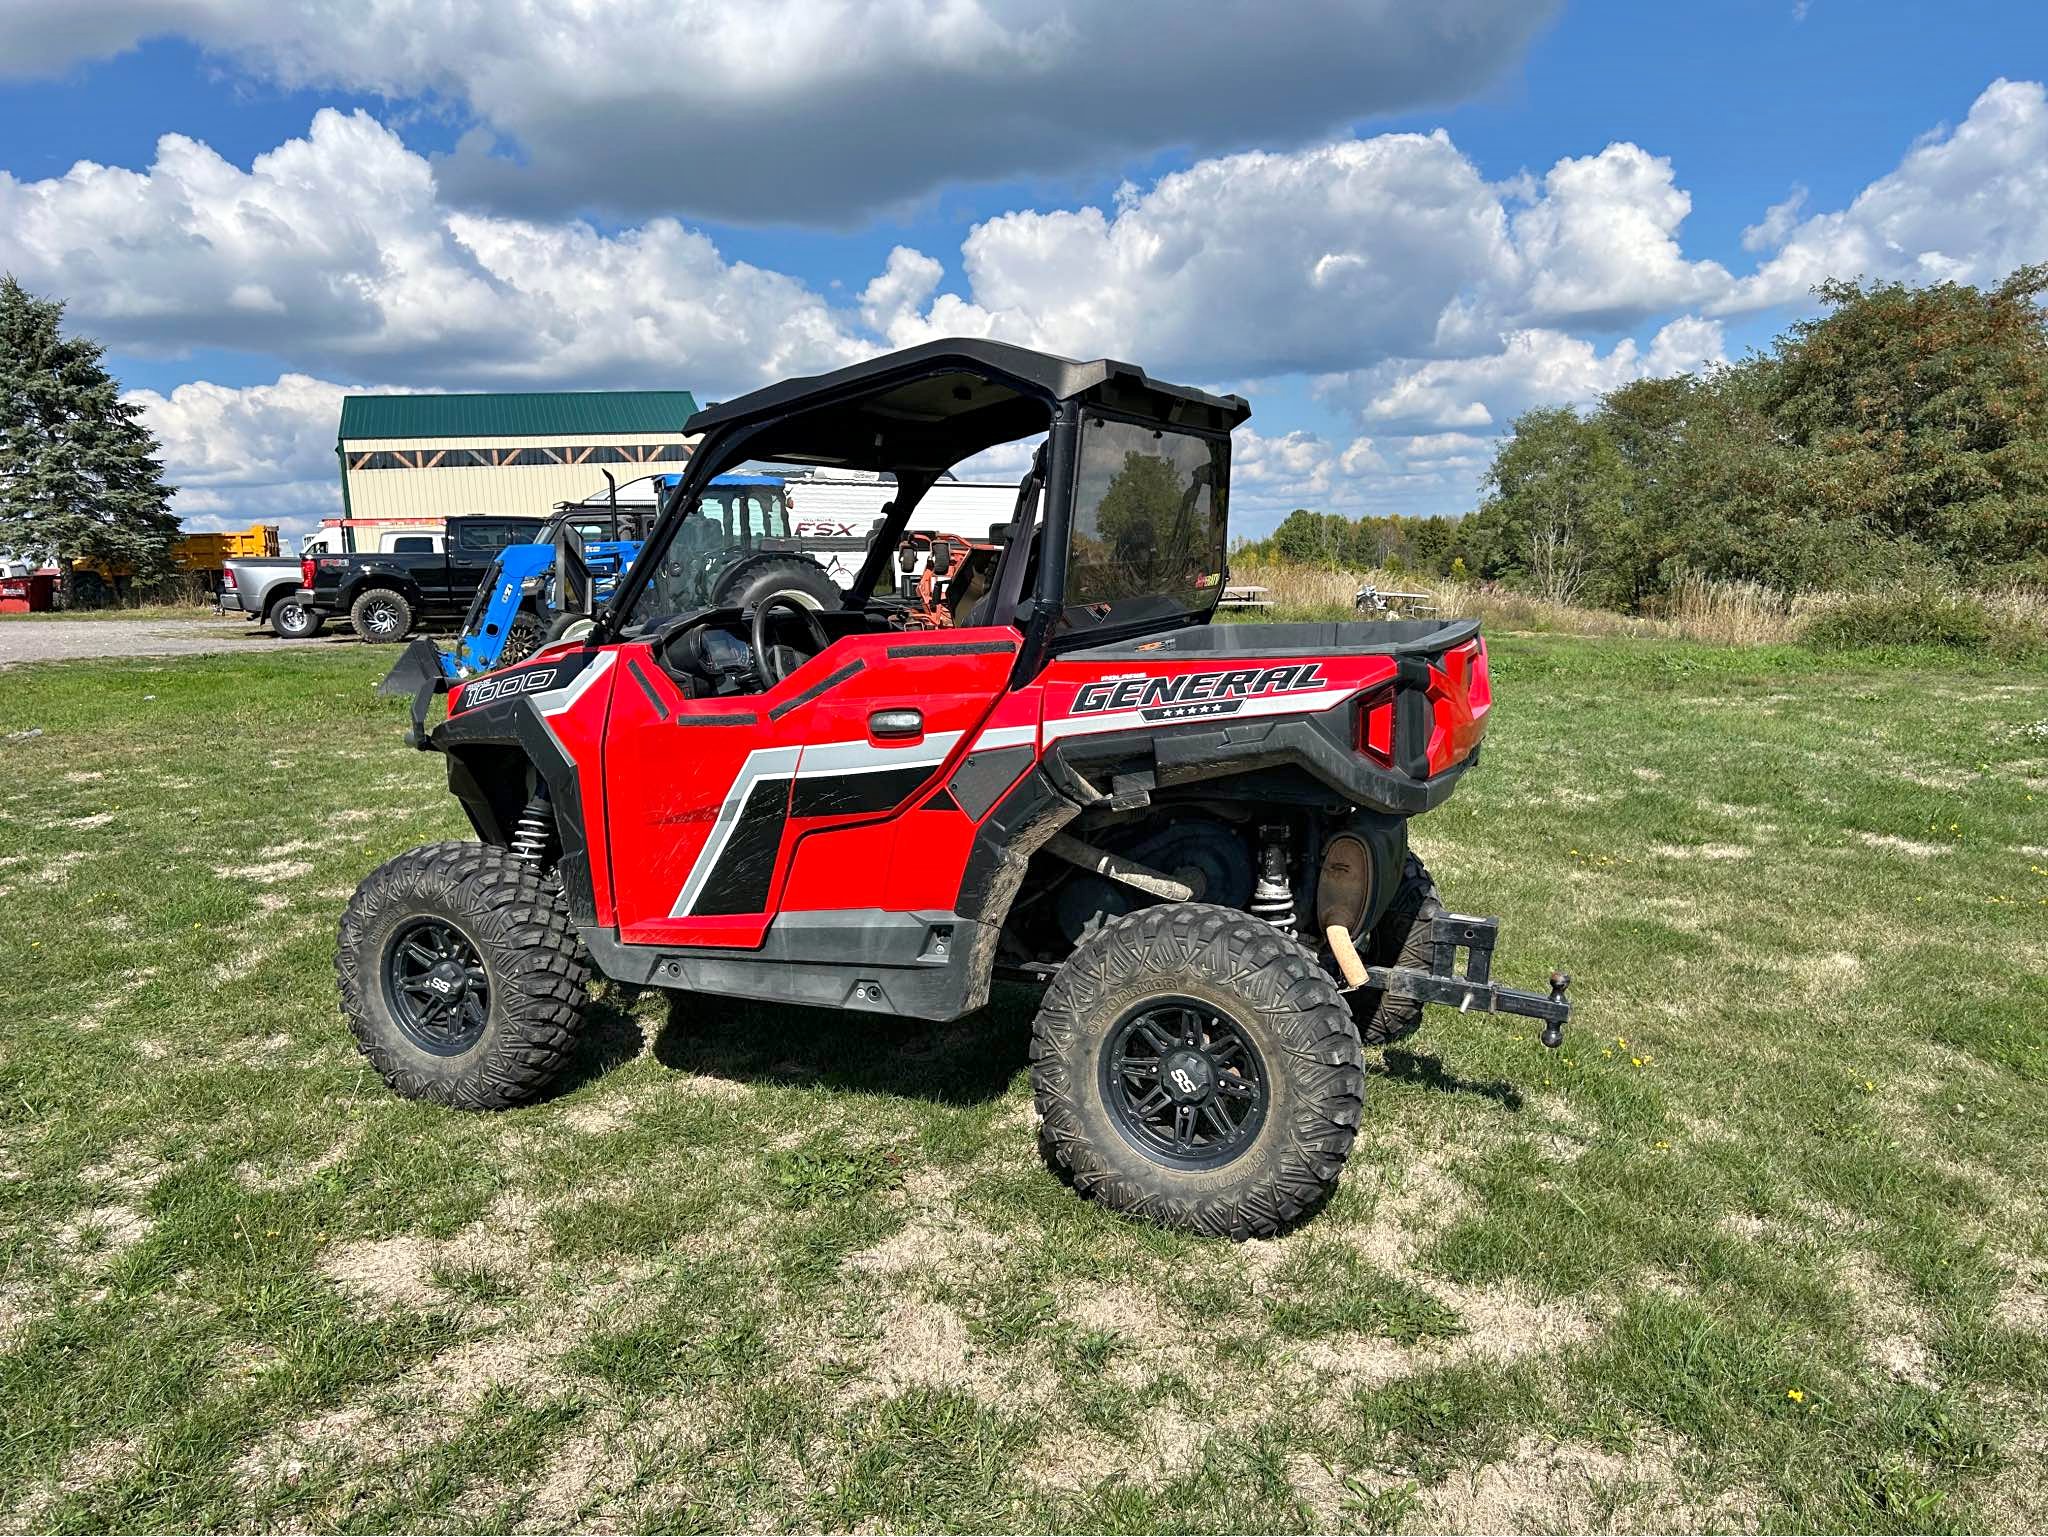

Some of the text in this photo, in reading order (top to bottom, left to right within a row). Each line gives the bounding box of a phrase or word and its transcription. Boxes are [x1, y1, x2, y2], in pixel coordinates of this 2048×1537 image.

[794, 522, 857, 536] FSX
[466, 669, 557, 707] 1000
[1068, 663, 1328, 715] GENERAL
[1101, 672, 1147, 682] POLARIS
[1170, 1068, 1197, 1094] SS
